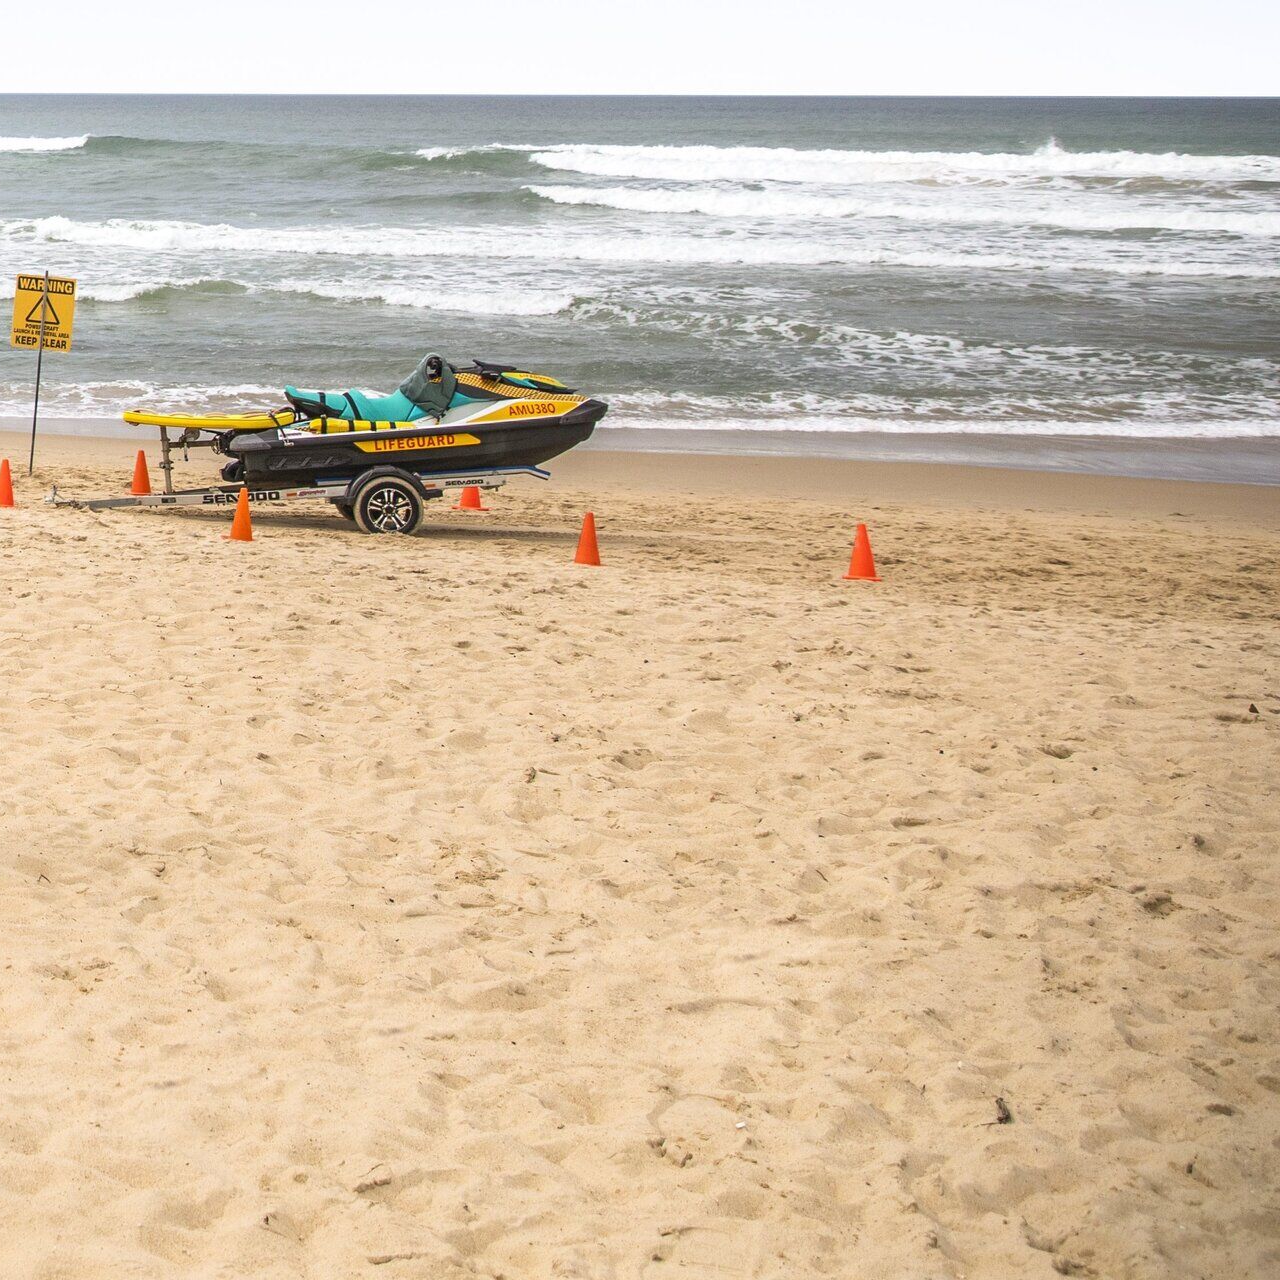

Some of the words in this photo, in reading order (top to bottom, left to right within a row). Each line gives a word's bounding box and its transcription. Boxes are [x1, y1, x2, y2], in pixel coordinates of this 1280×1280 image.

[20, 277, 73, 293] WARNING
[15, 335, 38, 346] KEEP
[374, 434, 455, 451] LIFEGUARD
